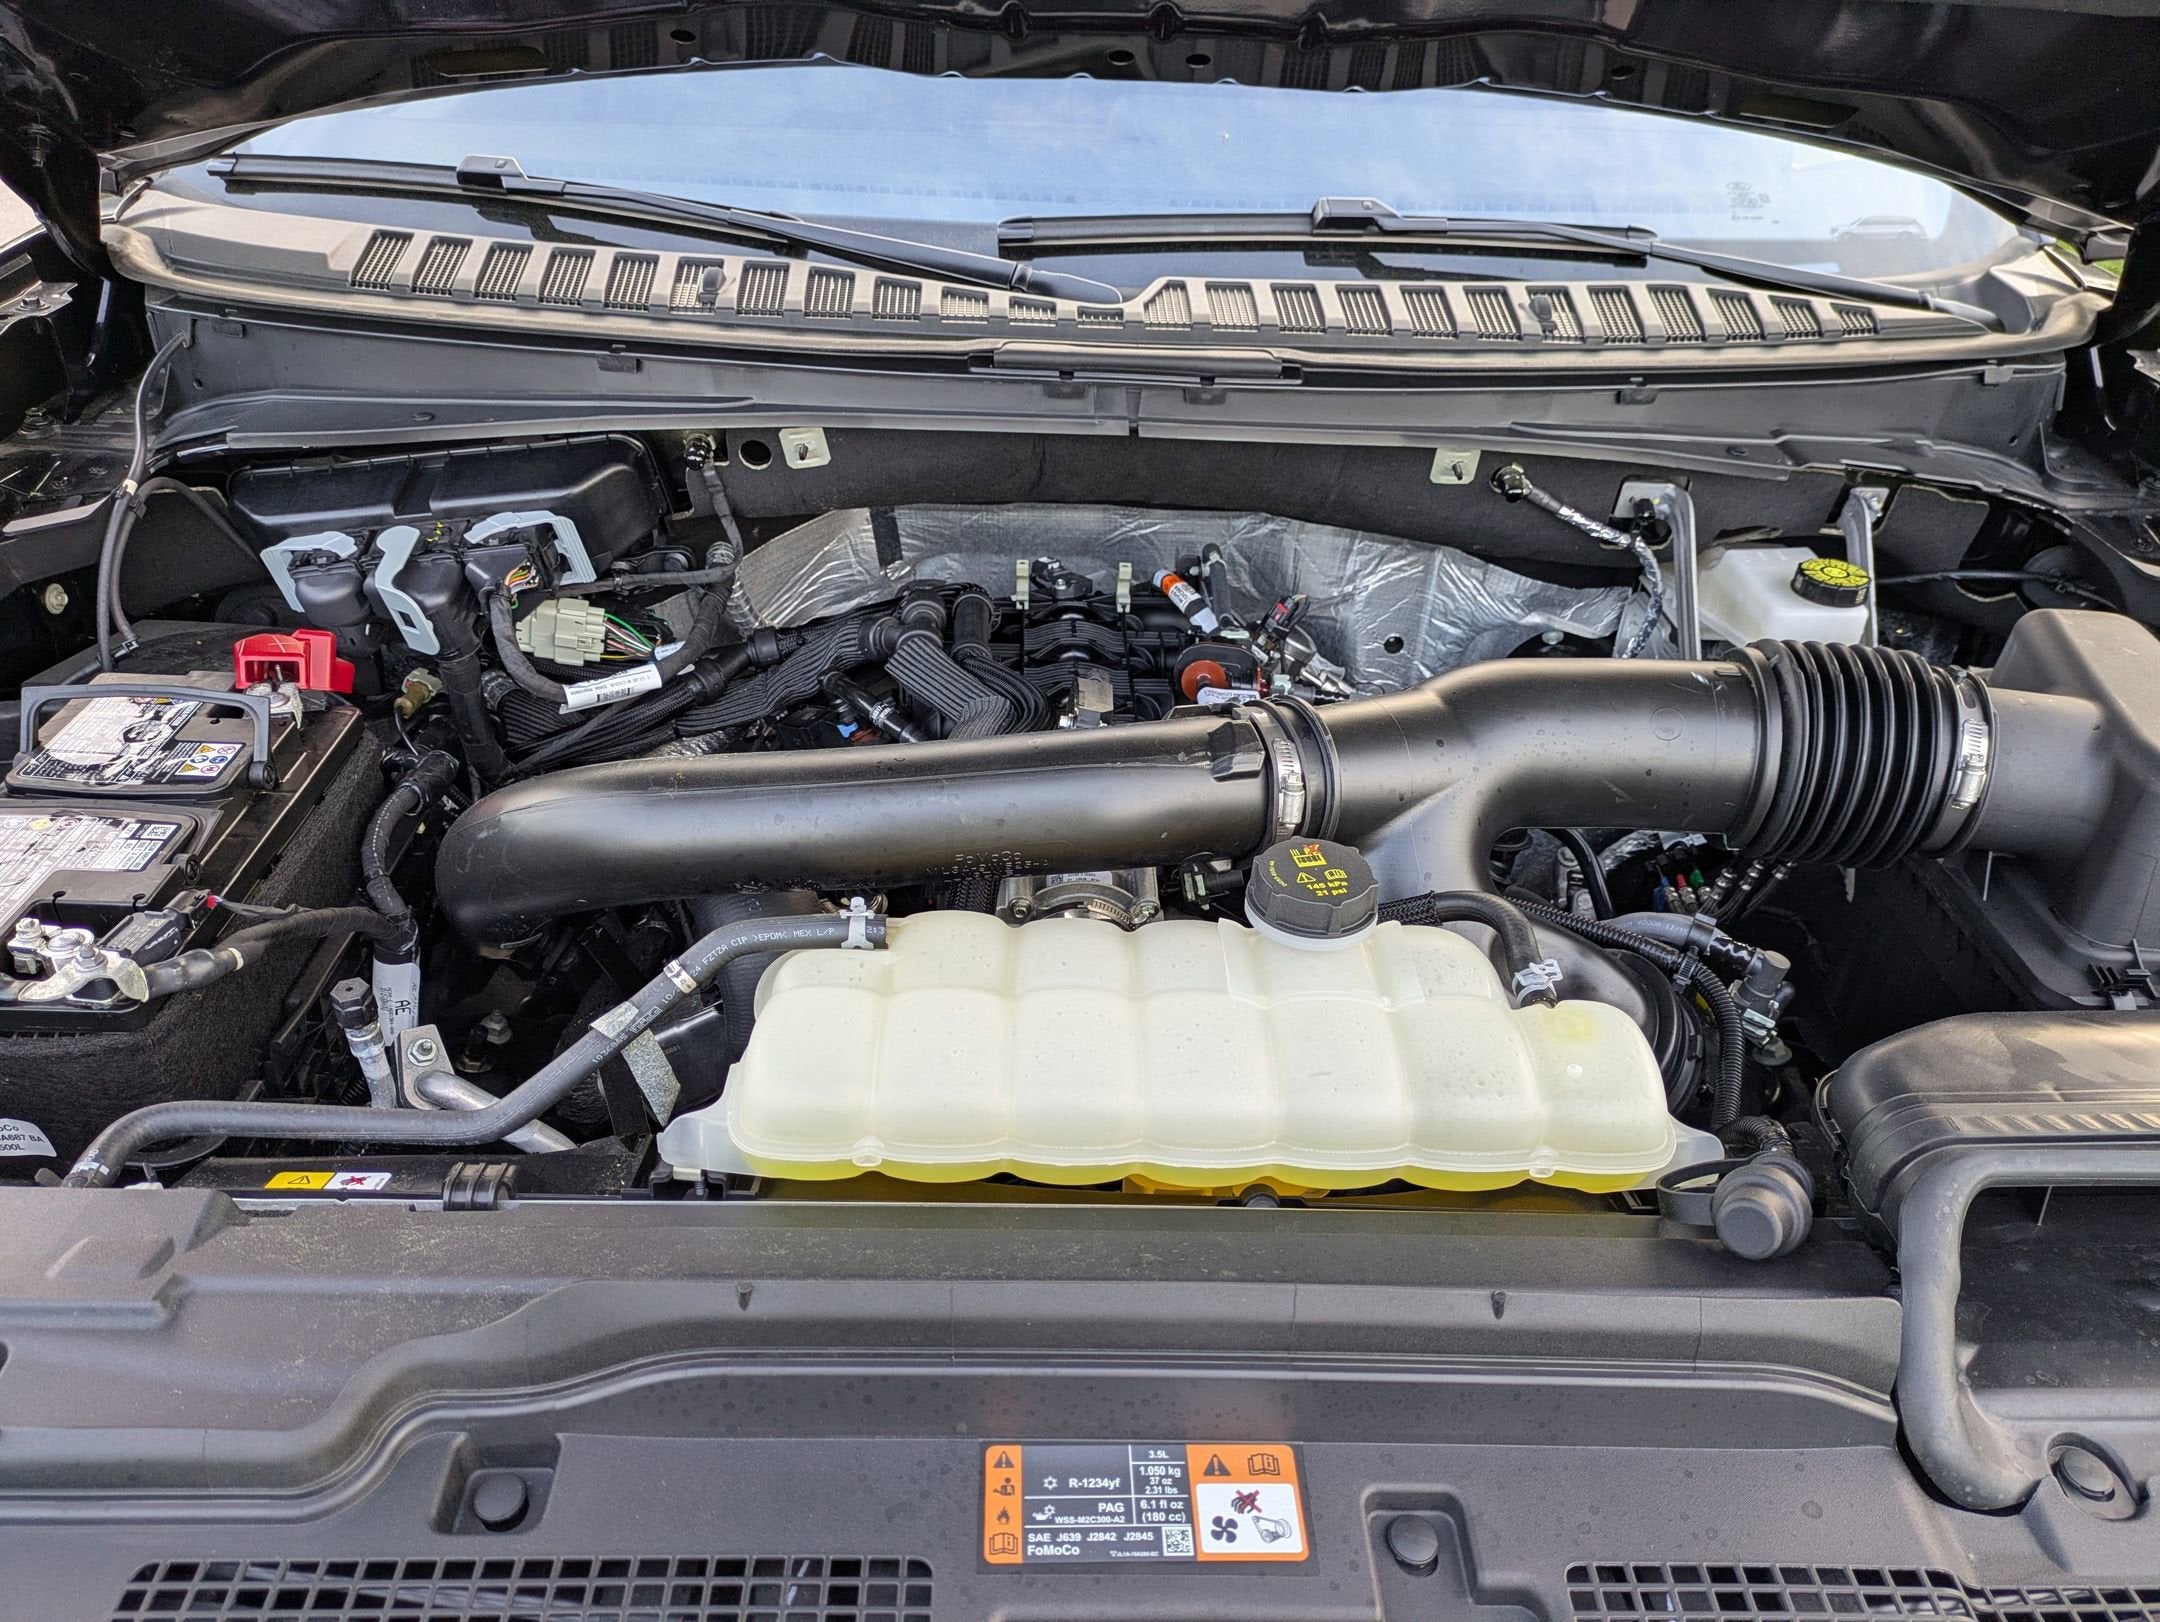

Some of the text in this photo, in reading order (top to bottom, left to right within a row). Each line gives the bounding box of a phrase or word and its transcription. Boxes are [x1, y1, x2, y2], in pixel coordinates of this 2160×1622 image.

[1306, 881, 1326, 890] 145
[1315, 887, 1348, 897] 21 psi
[730, 936, 749, 947] CIP
[793, 928, 812, 938] MEX
[816, 927, 836, 937] L/P
[394, 1000, 412, 1016] AE
[1148, 1450, 1170, 1459] 3.5L
[1139, 1465, 1181, 1478] 1.050 kg
[1068, 1477, 1121, 1490] R-1234yf
[1149, 1476, 1160, 1485] 37
[1145, 1485, 1178, 1494] 2.31 lbs
[1097, 1502, 1125, 1513] PAG
[1140, 1500, 1157, 1509] 6.1
[1159, 1500, 1168, 1509] fl
[1142, 1512, 1186, 1523] (180 cc)
[1027, 1532, 1154, 1542] SAE J639 J2842 J2845
[1027, 1544, 1081, 1556] FoMoCo
